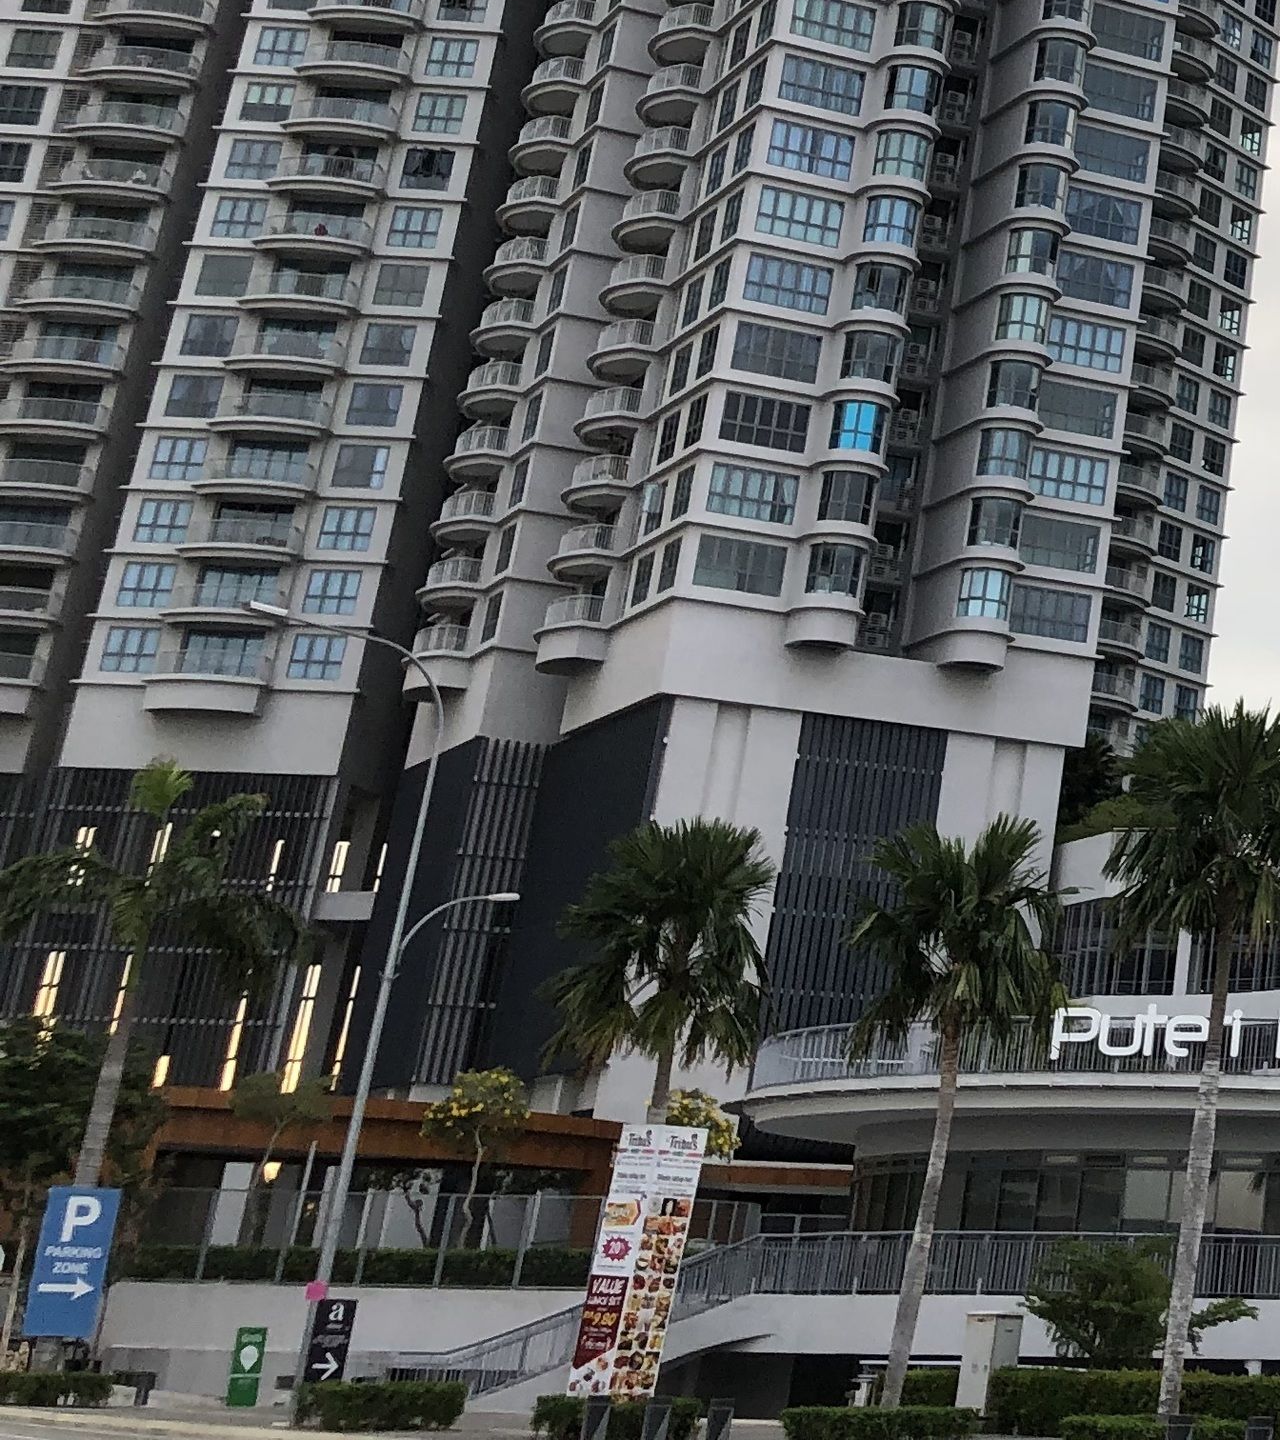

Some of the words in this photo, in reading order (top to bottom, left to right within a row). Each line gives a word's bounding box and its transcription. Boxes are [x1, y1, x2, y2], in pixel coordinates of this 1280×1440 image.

[1050, 1003, 1243, 1060] Putei
[60, 1195, 102, 1242] P
[44, 1246, 103, 1258] PARKING
[52, 1262, 88, 1274] ZONE
[592, 1278, 625, 1294] VALUE
